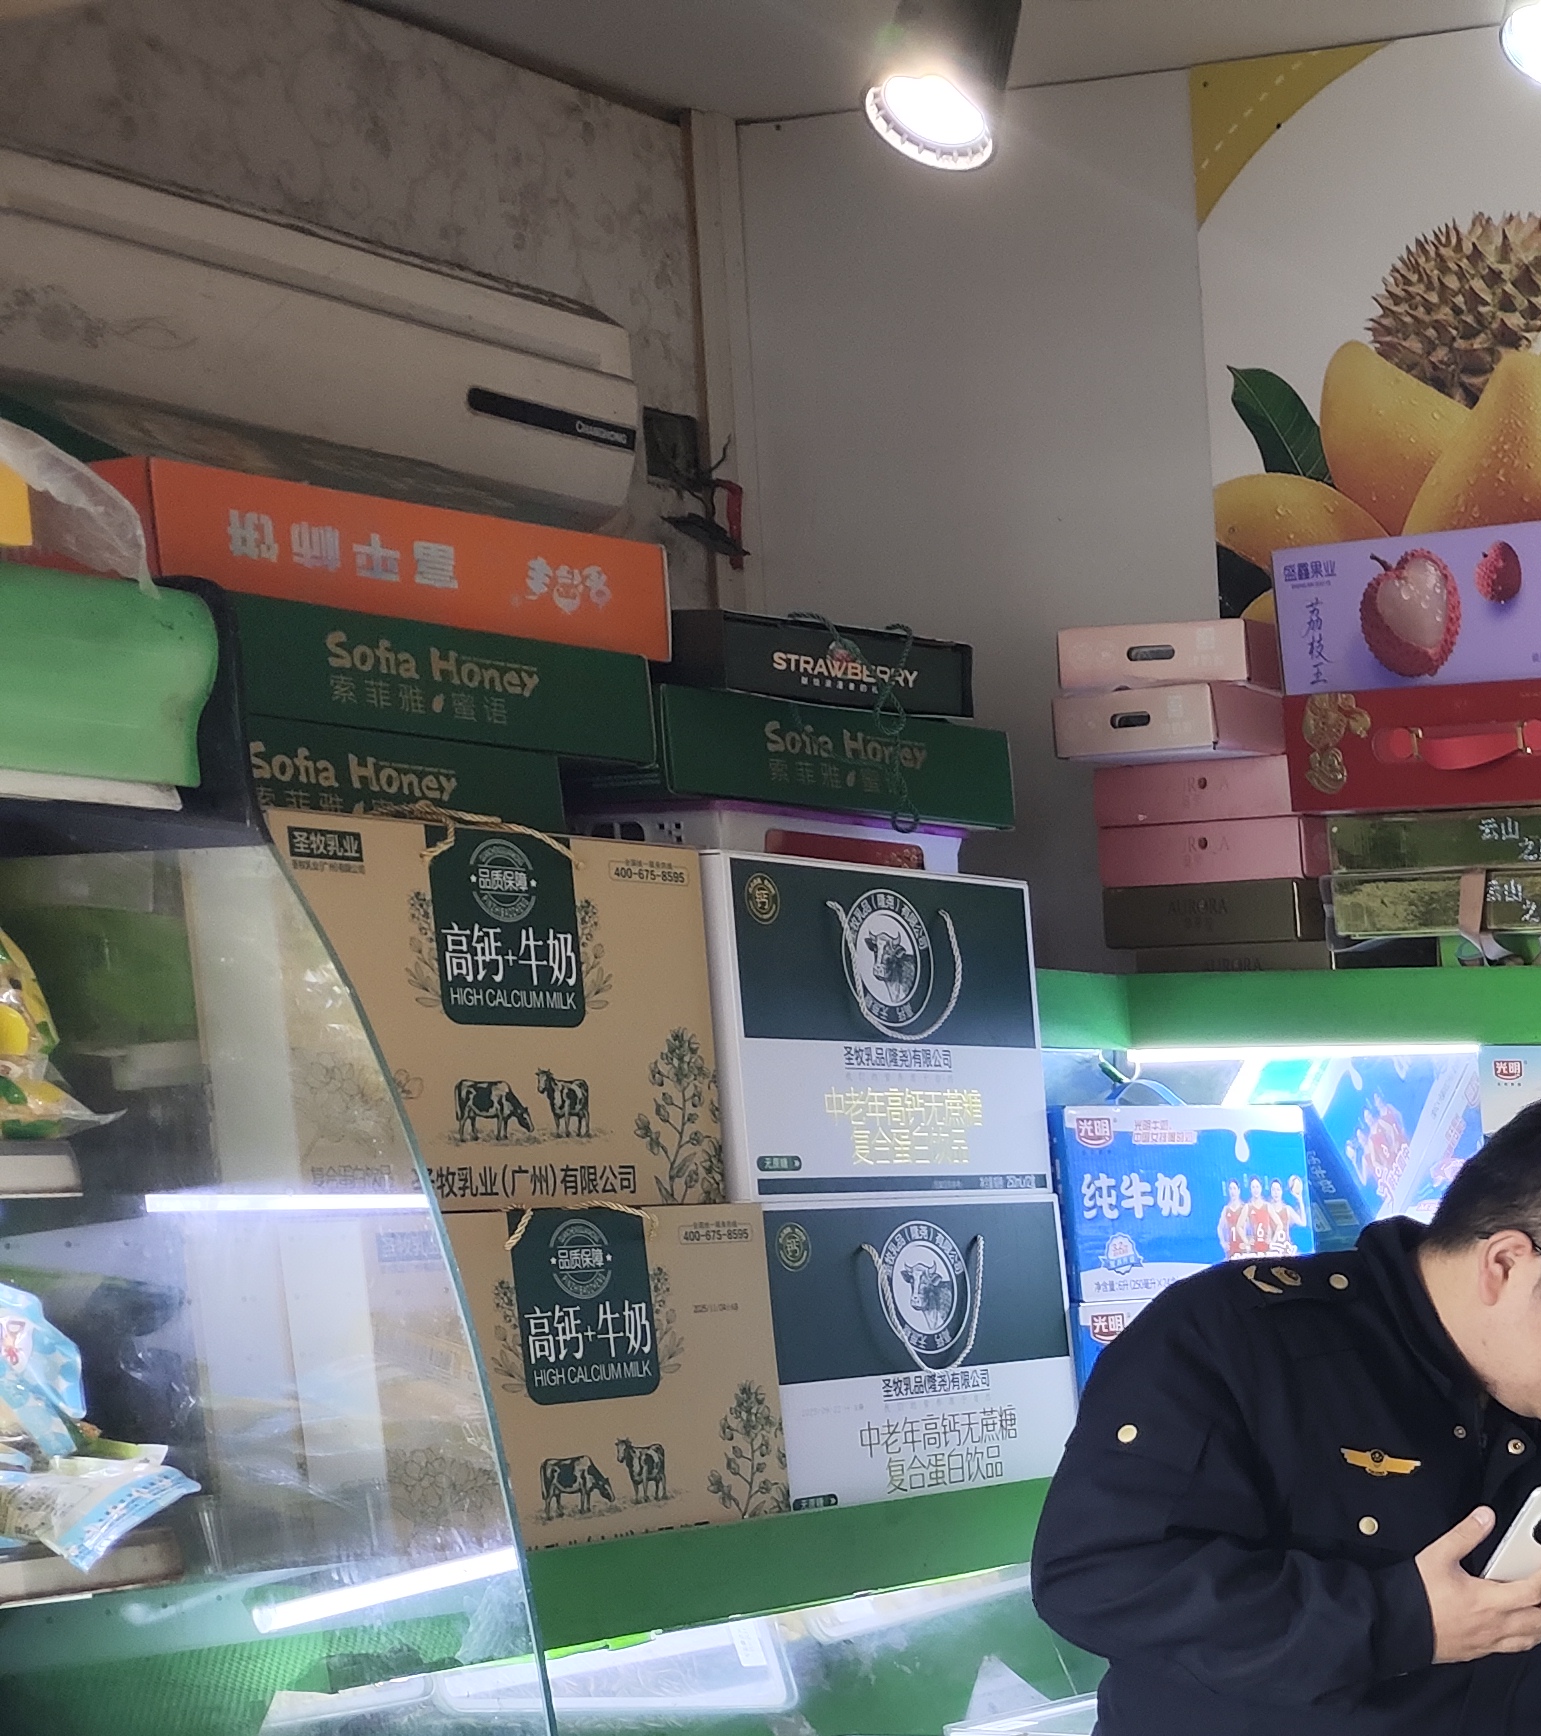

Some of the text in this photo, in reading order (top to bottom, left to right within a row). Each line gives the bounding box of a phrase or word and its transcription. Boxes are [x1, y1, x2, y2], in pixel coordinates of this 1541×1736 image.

[325, 630, 540, 698] Sofia Honey
[764, 719, 835, 758] Sofia
[348, 753, 459, 801] Honey
[440, 922, 577, 987] 高钙+牛奶
[449, 987, 483, 1007] HIGH
[485, 988, 545, 1009] CALCIUM
[1078, 1118, 1111, 1138] 光明
[1080, 1171, 1192, 1221] 纯牛奶
[523, 1299, 652, 1365] 高钙+牛奶
[533, 1367, 566, 1388] HIGH
[567, 1362, 622, 1385] CALCIUM
[858, 1403, 1018, 1459] 中老年高钙无蔗糖
[886, 1444, 1004, 1495] 复合蛋白饮品
